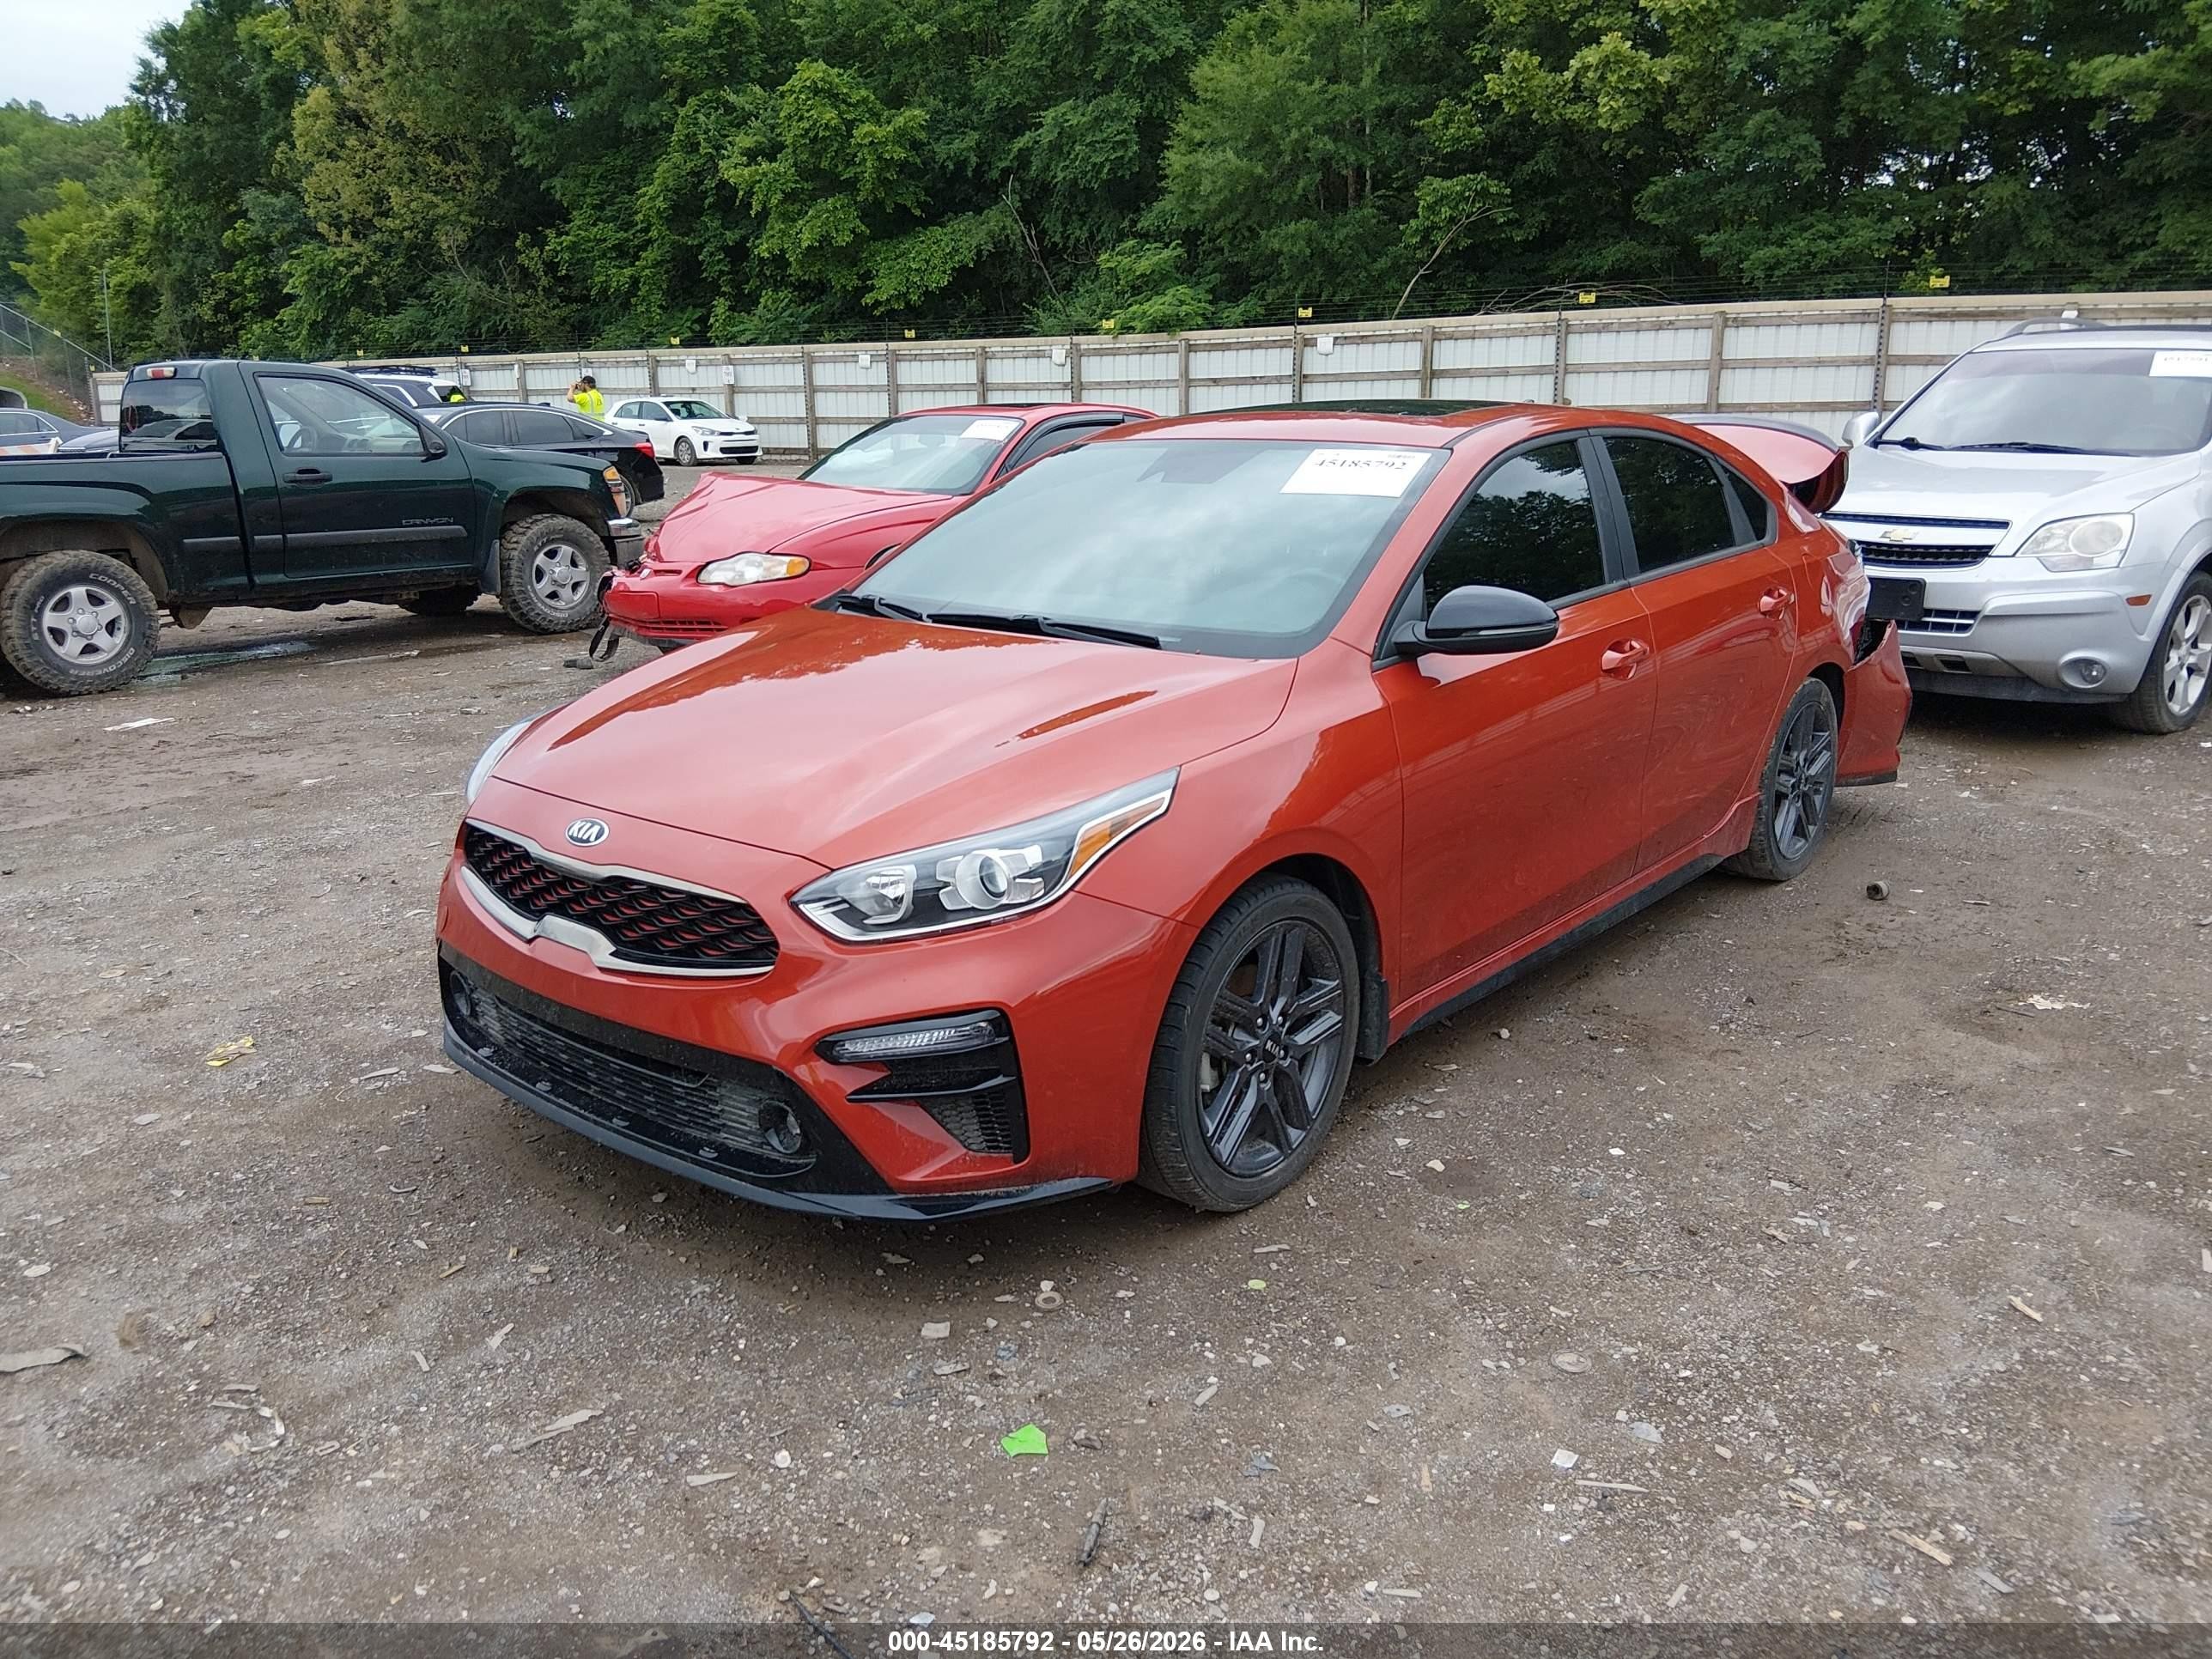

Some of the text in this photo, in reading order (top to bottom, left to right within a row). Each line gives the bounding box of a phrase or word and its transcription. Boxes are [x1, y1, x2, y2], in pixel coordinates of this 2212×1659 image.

[89, 573, 137, 605] COOPER
[568, 820, 601, 842] KIA
[1265, 1039, 1279, 1056] KIA
